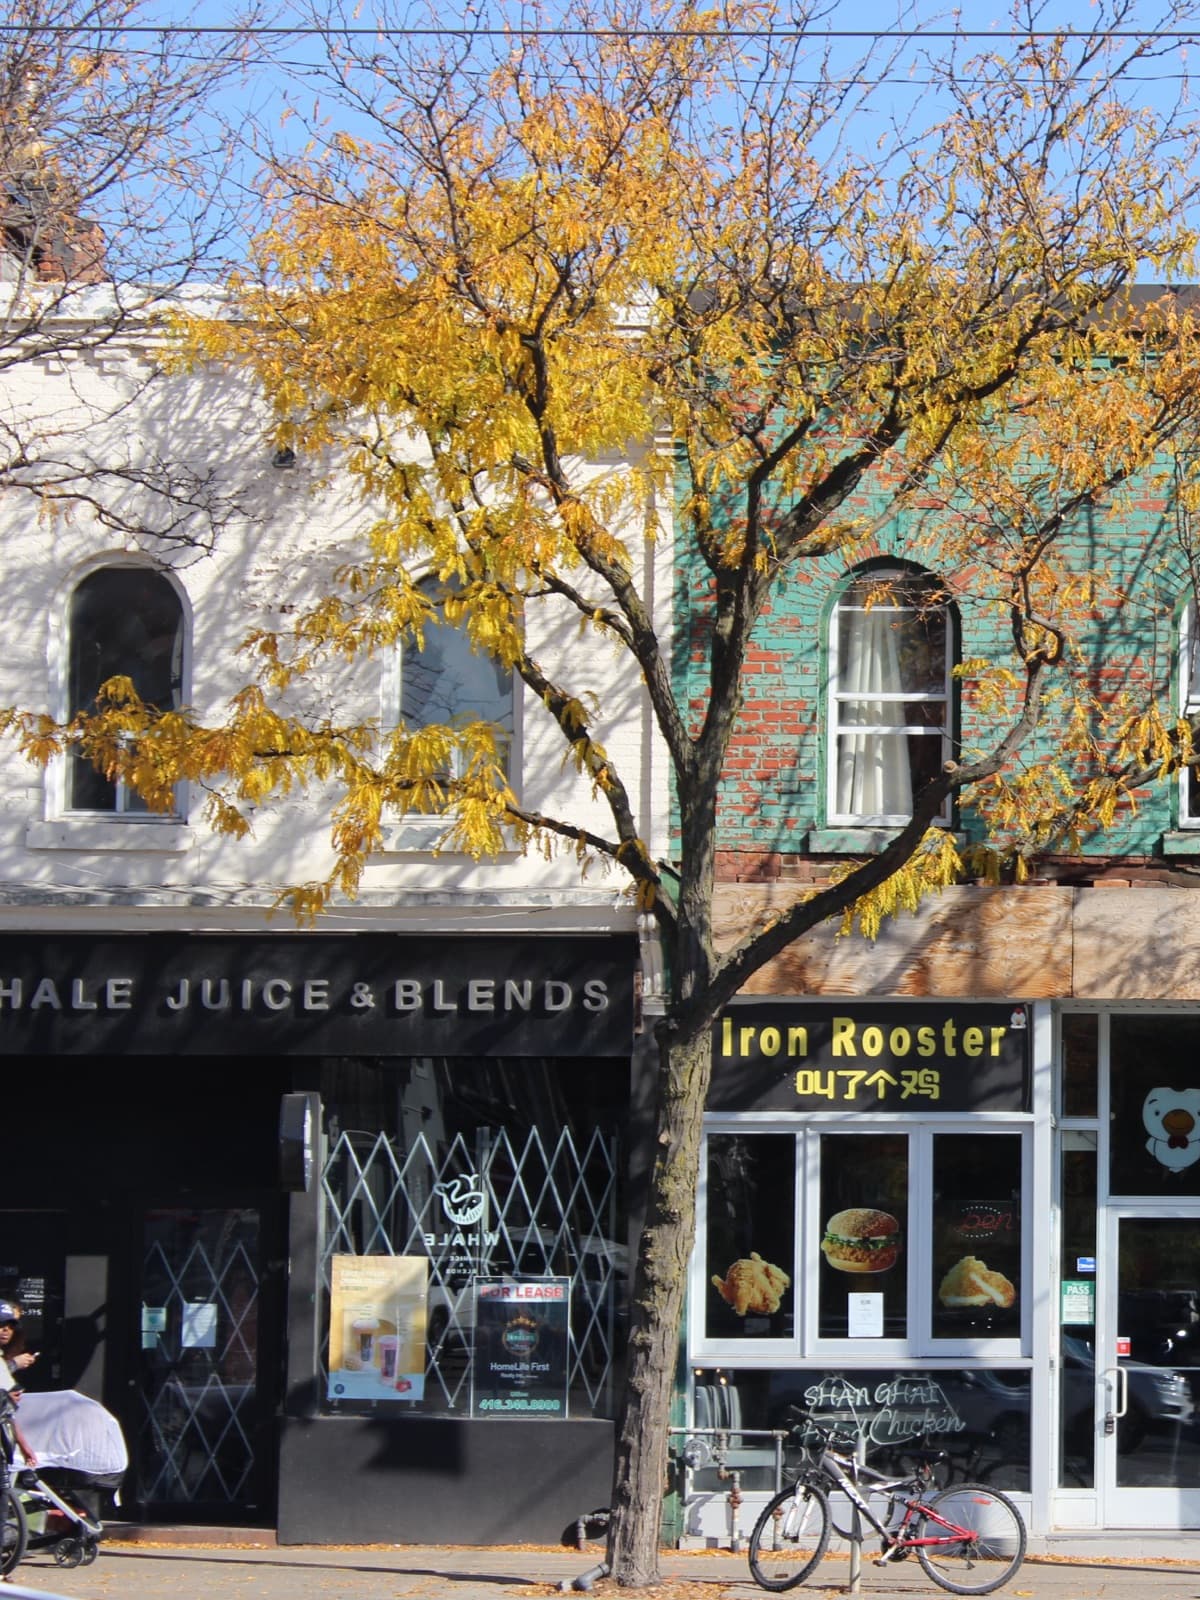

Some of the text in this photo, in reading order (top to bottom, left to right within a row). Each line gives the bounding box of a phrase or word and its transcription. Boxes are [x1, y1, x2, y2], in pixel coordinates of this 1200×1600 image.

[0, 978, 609, 1011] HALE JUICE & BLENDS
[722, 1017, 1007, 1057] Iron Rooster
[795, 1068, 941, 1100] 叫了个鸡
[481, 1286, 564, 1298] FOR LEASE
[1067, 1285, 1090, 1294] PASS
